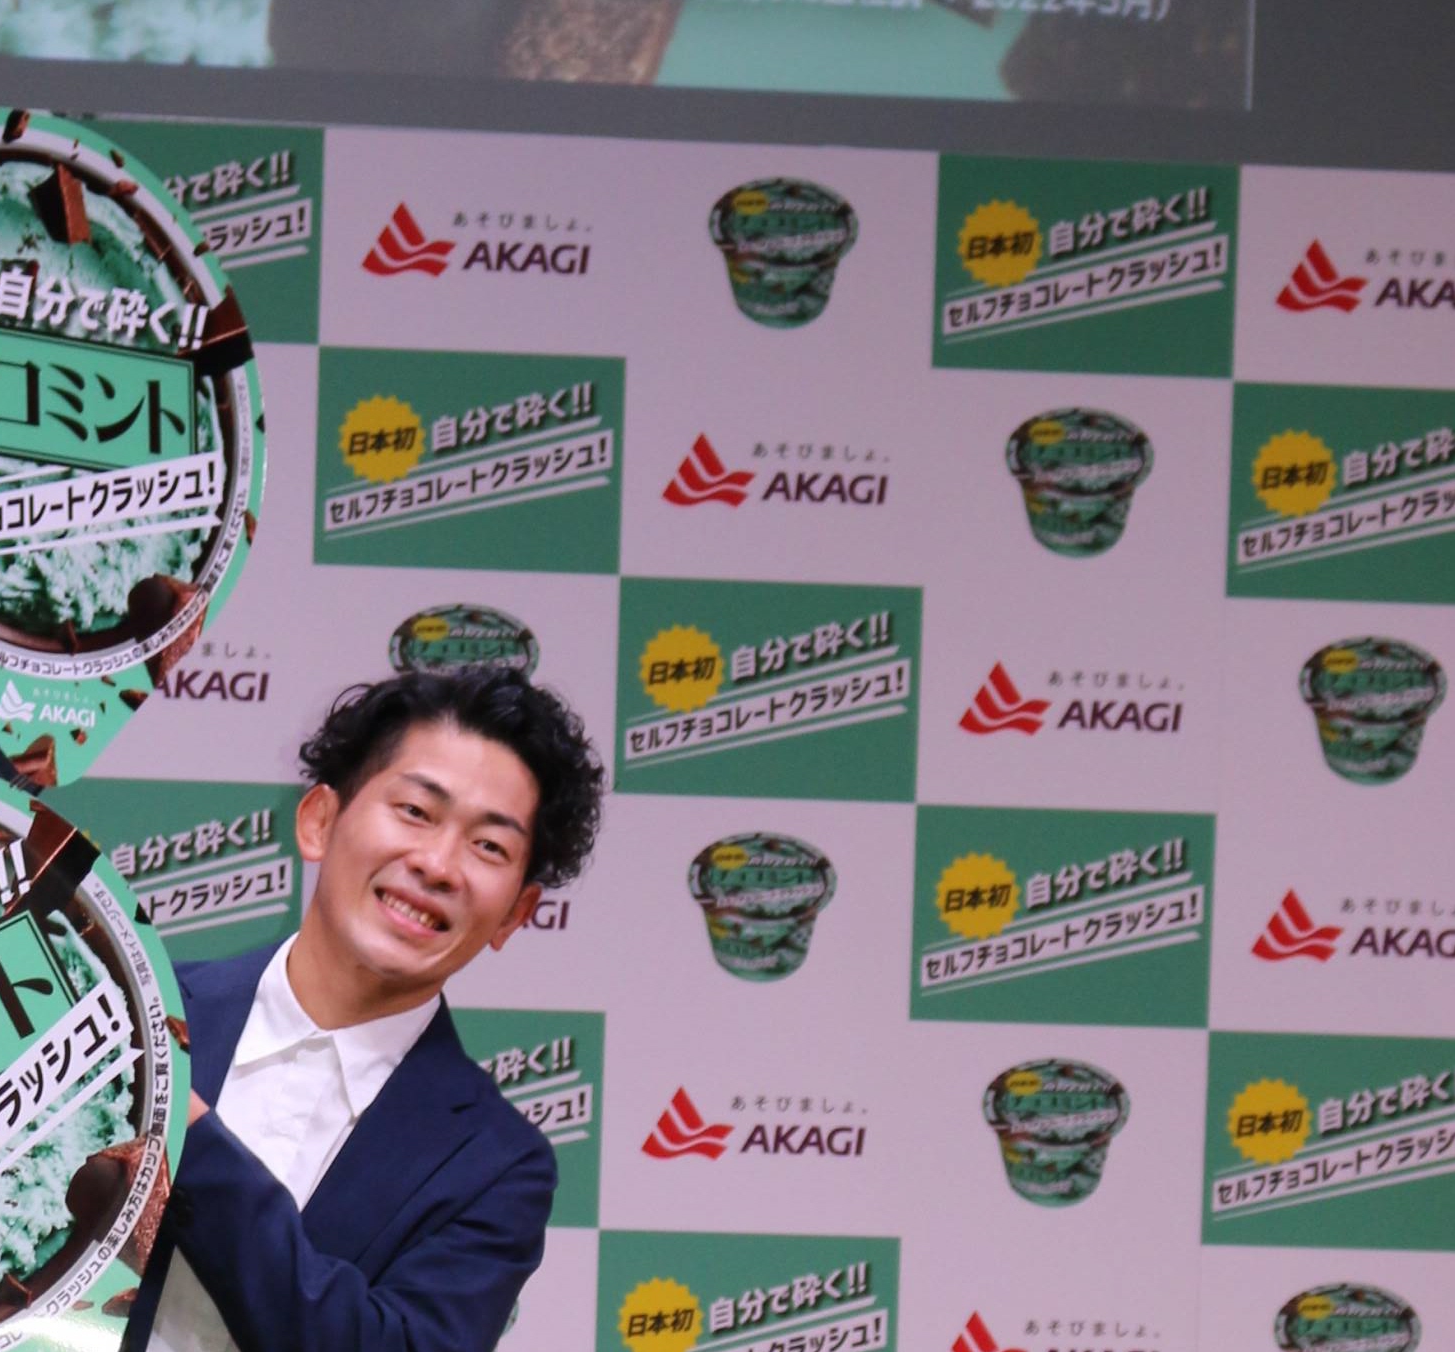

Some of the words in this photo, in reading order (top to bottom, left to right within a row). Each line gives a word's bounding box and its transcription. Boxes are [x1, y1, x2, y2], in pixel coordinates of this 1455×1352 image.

[461, 241, 591, 276] AKAGI
[966, 230, 1035, 260] 日本初
[348, 426, 417, 456] 日本初
[760, 471, 889, 506] AKAGI
[1260, 460, 1328, 490] 日本初
[647, 656, 716, 686] 日本初
[38, 704, 96, 728] AKAGI
[1056, 699, 1183, 733] AKAGI
[943, 883, 1012, 913] 日本初
[1236, 1107, 1304, 1138] 日本初
[738, 1124, 866, 1157] AKAGI
[626, 1307, 694, 1338] 日本初
